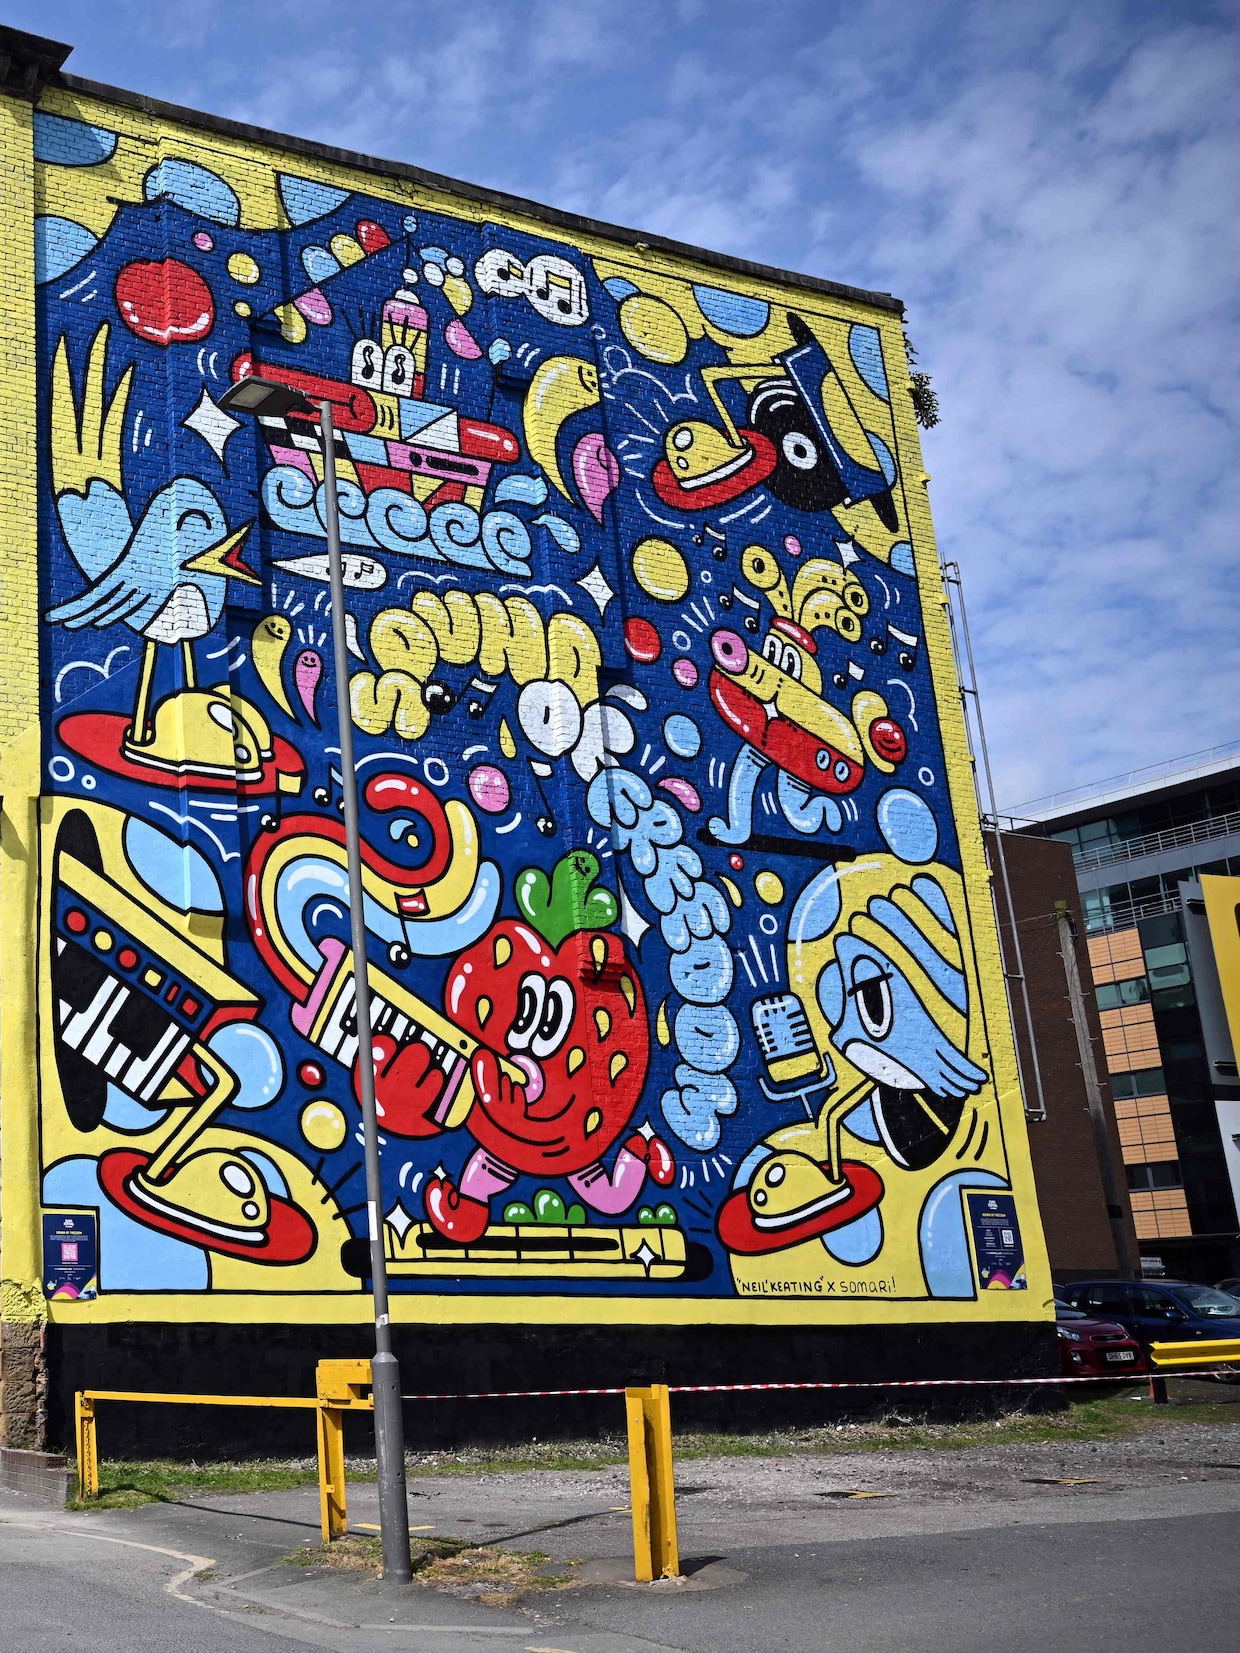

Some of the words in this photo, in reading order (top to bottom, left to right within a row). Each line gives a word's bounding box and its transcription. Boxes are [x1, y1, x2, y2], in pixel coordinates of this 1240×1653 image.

[349, 590, 602, 740] SOUND
[517, 679, 636, 783] OF
[587, 766, 740, 1152] FREEDOM
